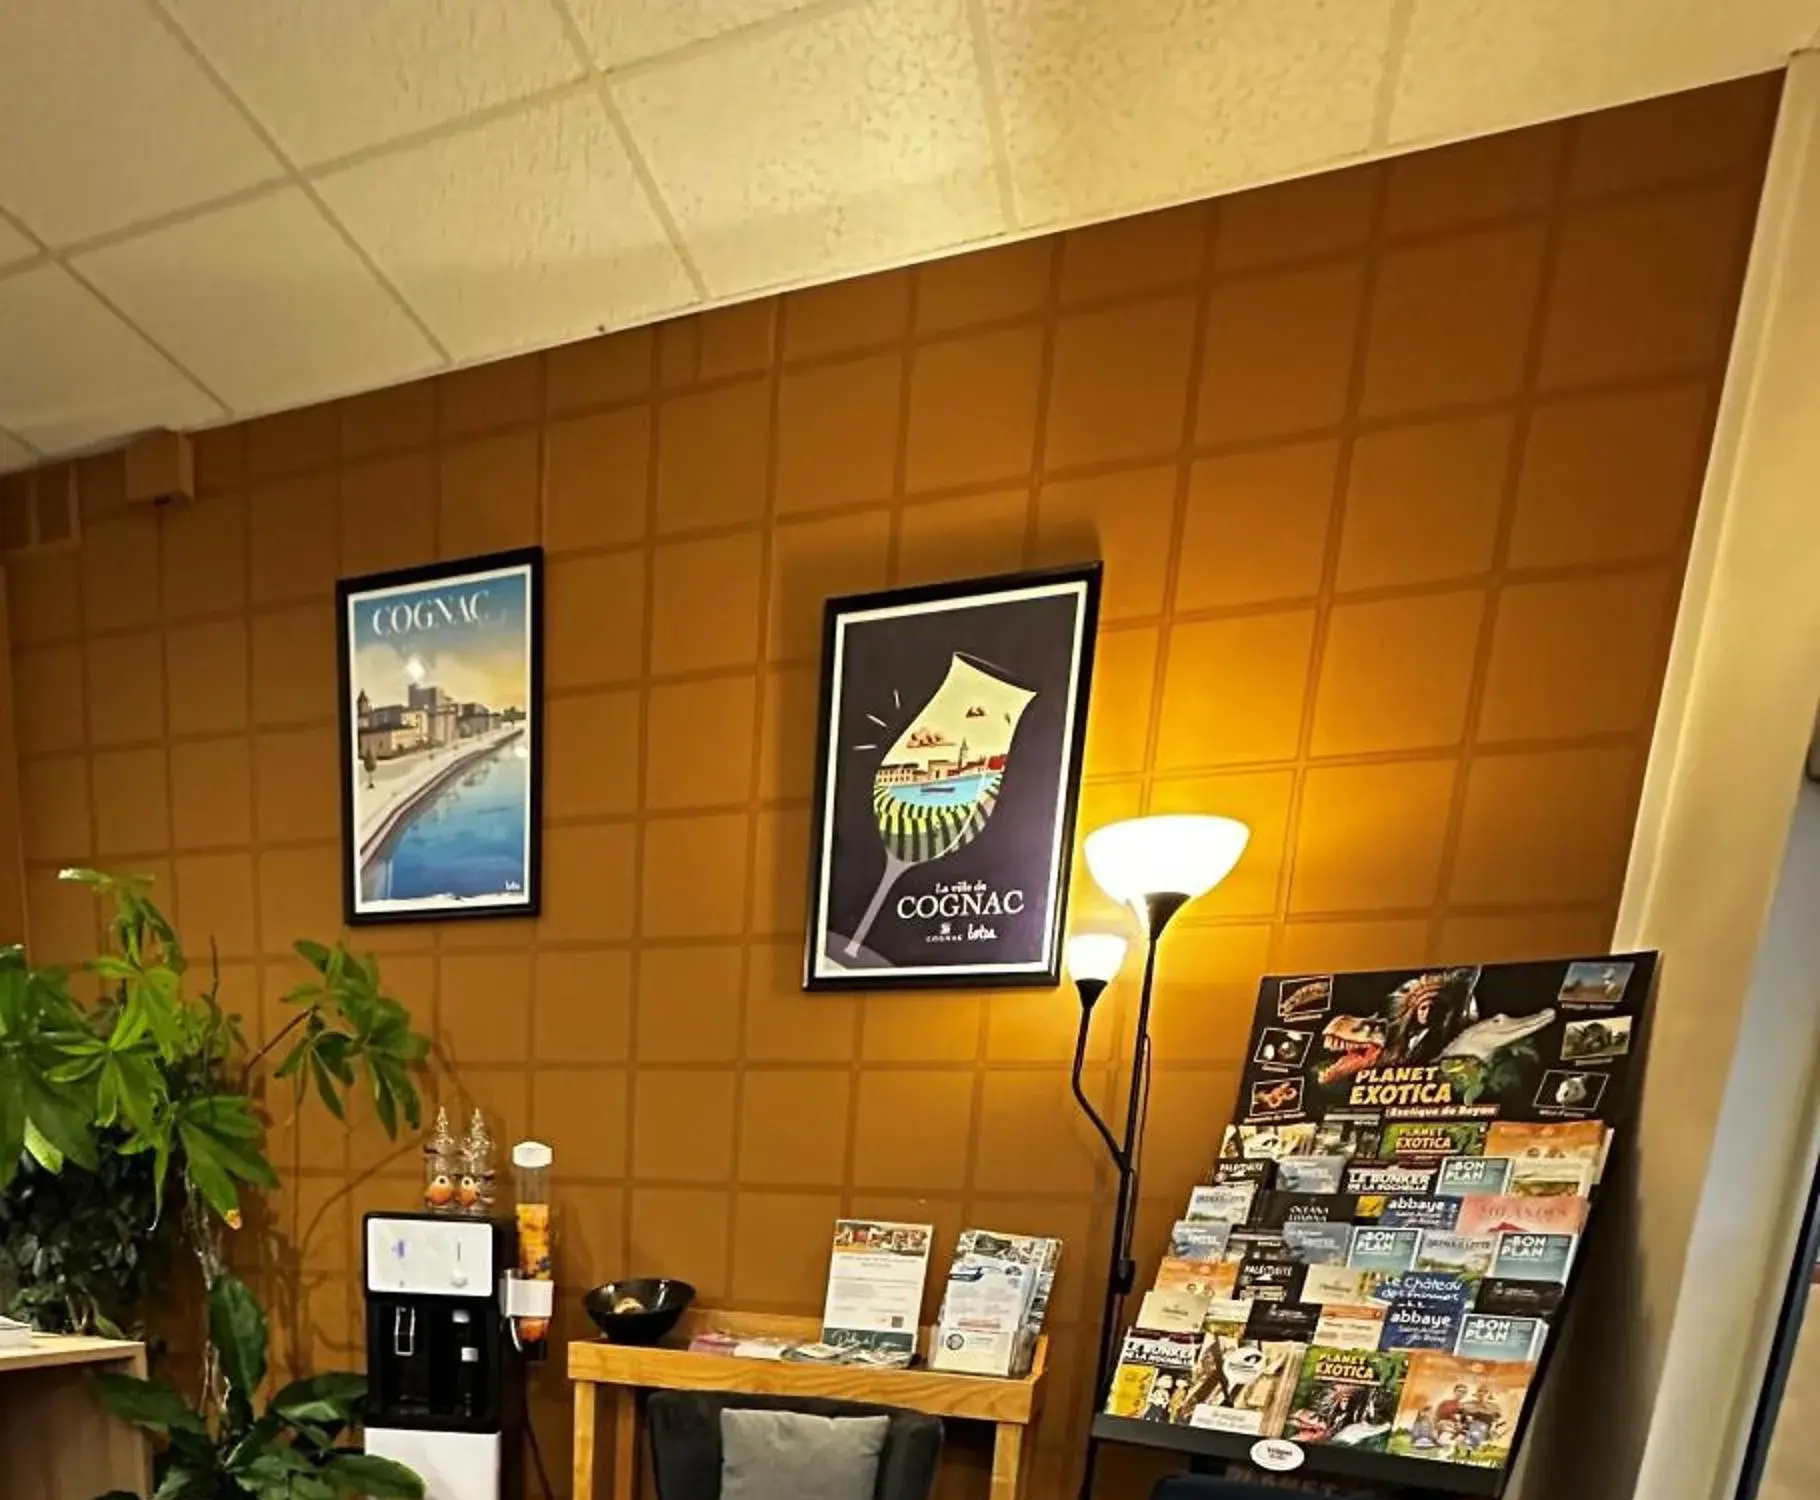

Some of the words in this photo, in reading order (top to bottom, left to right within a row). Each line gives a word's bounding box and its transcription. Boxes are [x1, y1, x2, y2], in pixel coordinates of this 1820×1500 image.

[372, 589, 491, 637] COGNAC
[897, 890, 1025, 919] COGNAC
[1355, 1066, 1440, 1084] PLANET
[1350, 1083, 1452, 1105] EXOTICA
[1400, 1127, 1443, 1137] PLANET
[1396, 1137, 1451, 1149] EXOTICA
[1456, 1161, 1485, 1171] BON
[1370, 1173, 1431, 1185] BUNKER
[1445, 1170, 1484, 1181] PLAN
[1388, 1197, 1445, 1212] abbaye
[1367, 1231, 1395, 1240] BON
[1513, 1235, 1547, 1247] BON
[1357, 1240, 1393, 1250] PLAN
[1501, 1246, 1544, 1257] PLAN
[1391, 1310, 1452, 1328] abbaye
[1477, 1319, 1511, 1330] BON
[1464, 1329, 1508, 1341] PLAN
[1320, 1353, 1366, 1365] PLANET
[1315, 1363, 1375, 1379] EXOTICA
